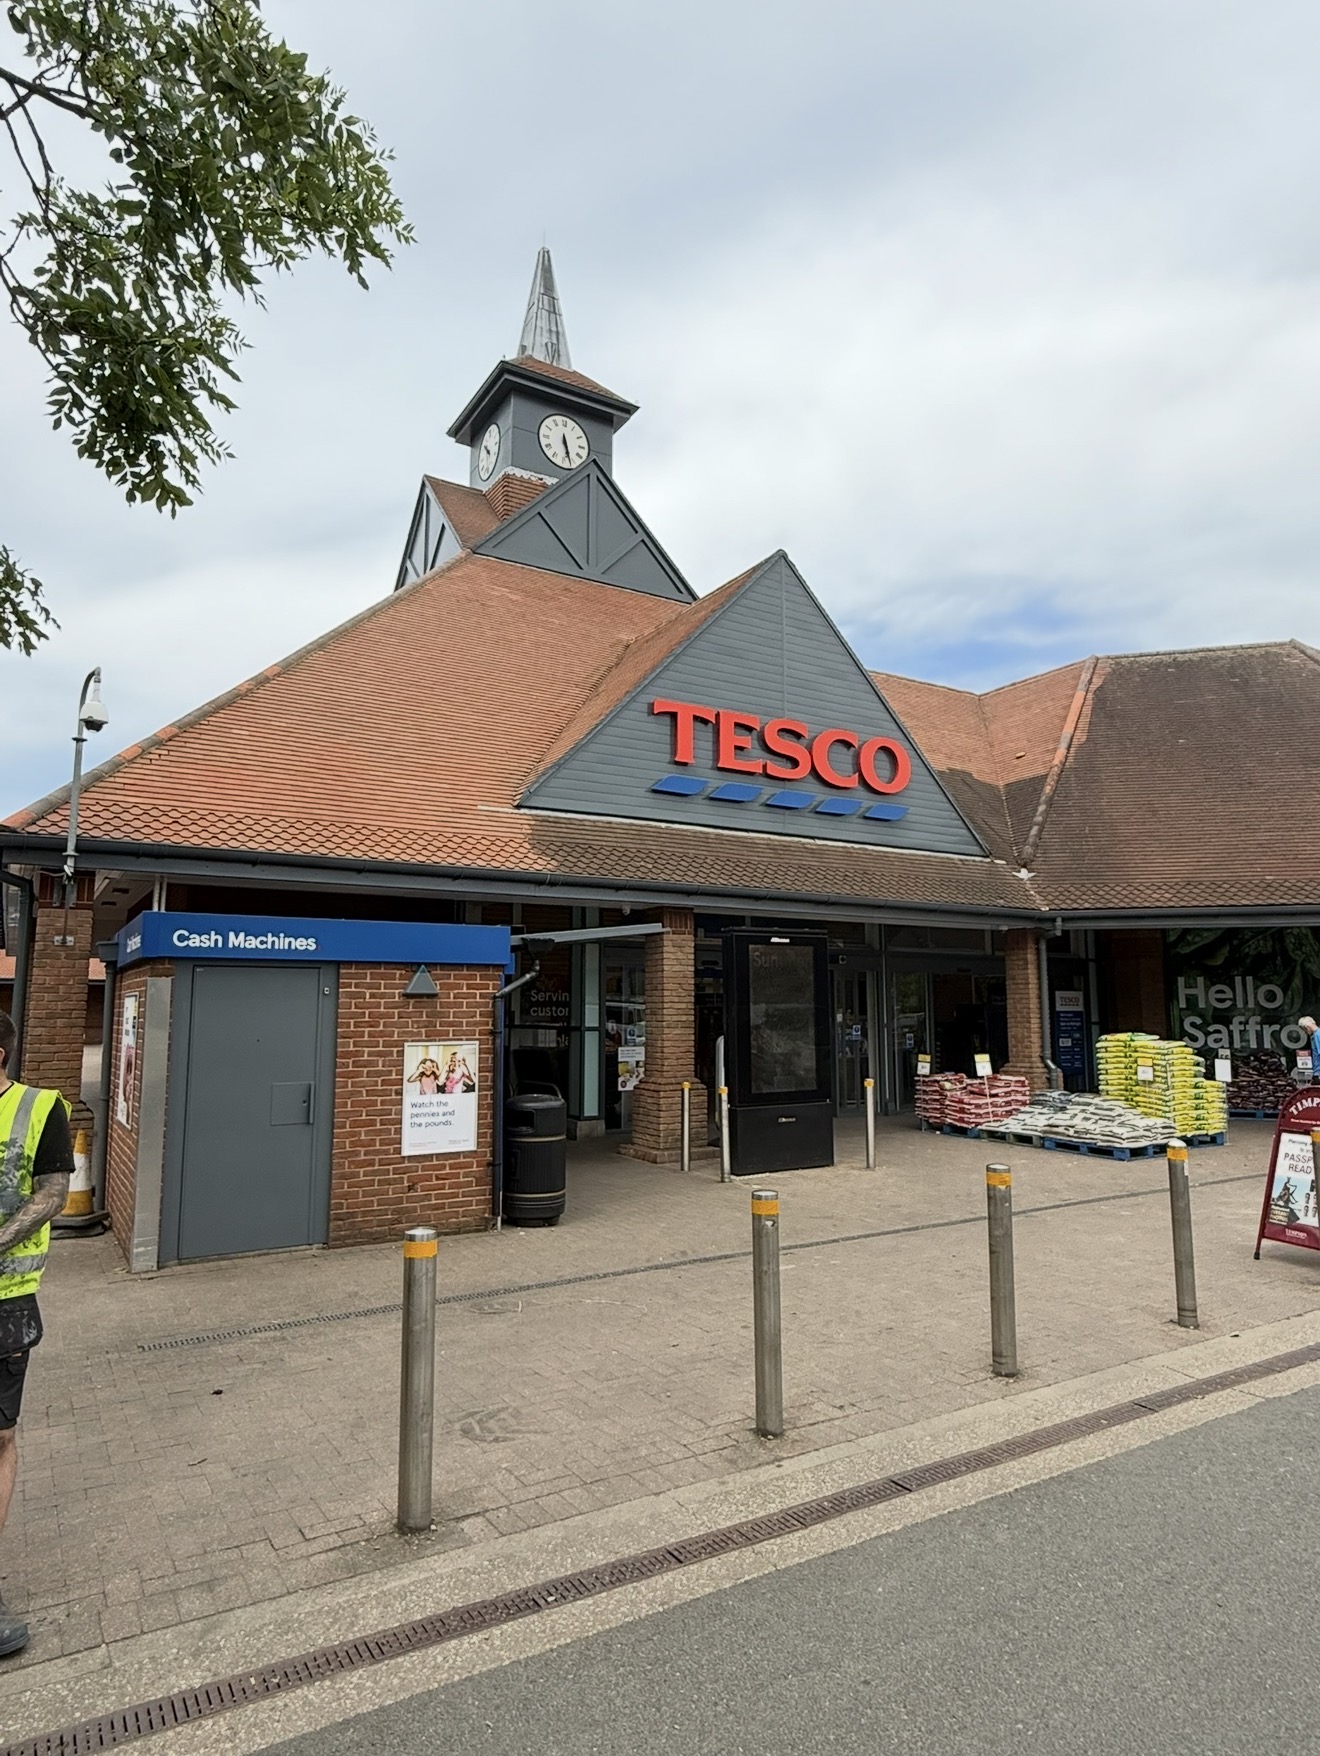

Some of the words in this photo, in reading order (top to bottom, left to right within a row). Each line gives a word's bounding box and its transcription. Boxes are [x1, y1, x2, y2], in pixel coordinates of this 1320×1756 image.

[652, 698, 912, 795] TESCO
[172, 929, 222, 948] Cash
[228, 931, 317, 951] Machines
[530, 989, 570, 1002] Servin
[1177, 975, 1284, 1009] Hello
[1182, 1015, 1308, 1050] Saffro
[410, 1101, 435, 1109] Watch
[410, 1111, 440, 1119] pennies
[441, 1109, 456, 1117] and
[1284, 1152, 1313, 1163] PASSP
[1288, 1163, 1313, 1174] READ
